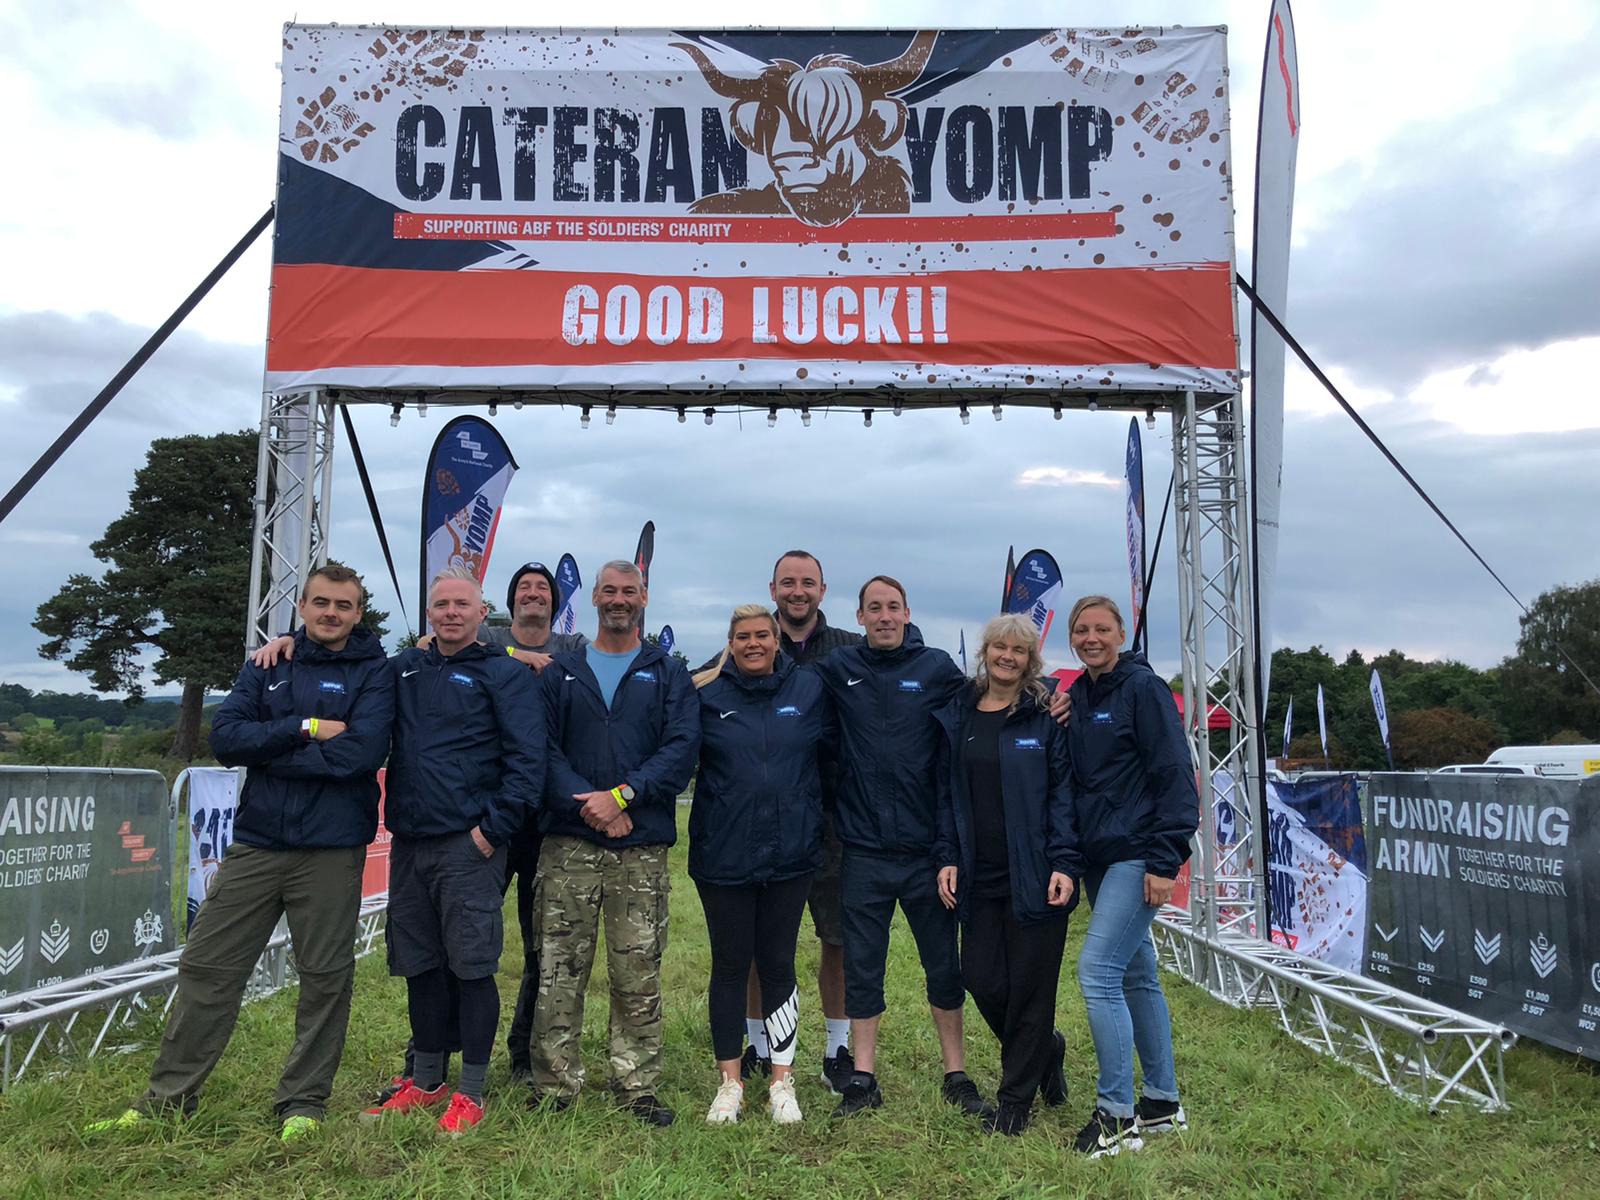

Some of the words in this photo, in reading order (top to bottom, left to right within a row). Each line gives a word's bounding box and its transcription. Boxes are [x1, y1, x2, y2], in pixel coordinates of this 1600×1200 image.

[395, 104, 747, 203] CATERAN
[904, 105, 1113, 204] YOMP
[424, 219, 518, 235] SUPPORTING
[522, 221, 551, 235] ABF
[556, 222, 584, 236] THE
[588, 221, 664, 237] SOLDIERS'
[669, 223, 732, 237] CHARITY
[561, 284, 724, 346] GOOD
[753, 286, 948, 345] LUCK!!
[463, 494, 494, 553] YOMP
[0, 796, 95, 836] AISING
[1374, 796, 1569, 847] FUNDRAISING
[49, 845, 74, 861] FOR
[76, 843, 92, 859] THE
[1376, 837, 1451, 878] ARMY
[1456, 846, 1507, 869] TOGETHER
[1508, 854, 1533, 872] FOR
[1534, 857, 1564, 876] THE
[46, 863, 90, 883] CHARITY
[1513, 876, 1568, 897] CHARITY
[1417, 975, 1432, 986] CPL
